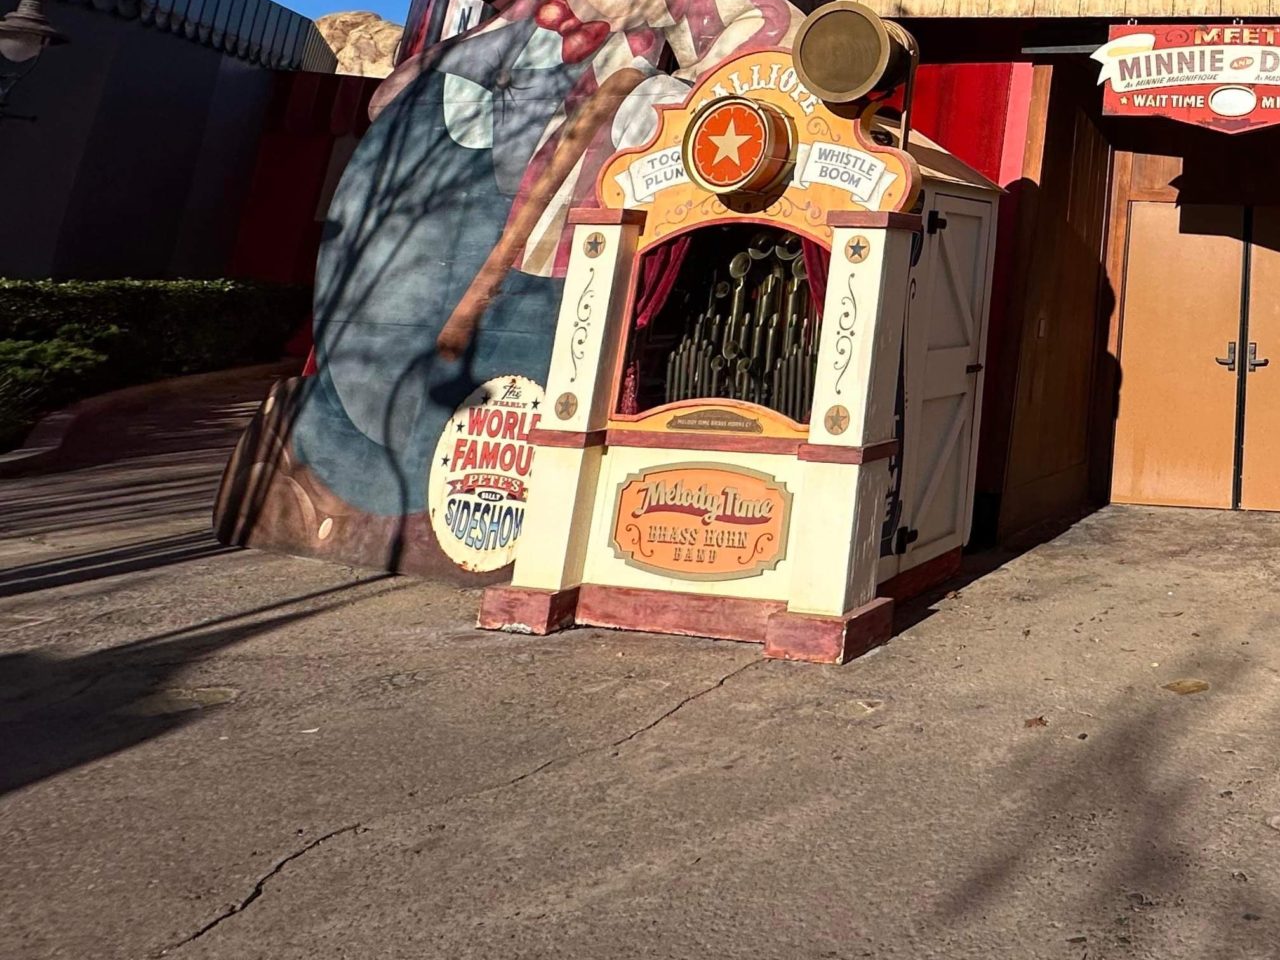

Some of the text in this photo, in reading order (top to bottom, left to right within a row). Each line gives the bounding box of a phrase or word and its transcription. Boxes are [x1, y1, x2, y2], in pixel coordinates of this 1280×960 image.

[1194, 28, 1280, 44] MEET
[1118, 50, 1224, 81] MINNIE
[1231, 58, 1252, 69] AND
[690, 63, 823, 116] ALLIOPE
[1136, 77, 1165, 88] MINNIE
[1166, 73, 1220, 84] MAGNIFIQUE
[1133, 95, 1169, 108] WAIT
[1171, 95, 1204, 108] TIME
[818, 147, 877, 176] WHISTLE
[818, 166, 862, 188] BOOM
[502, 383, 522, 400] The
[492, 400, 528, 409] NEARLY
[450, 438, 536, 477] FAMOU
[467, 475, 520, 492] PETE'S
[631, 479, 775, 526] Melody Time
[648, 525, 749, 549] BRASS HORN
[673, 547, 717, 563] BAND
